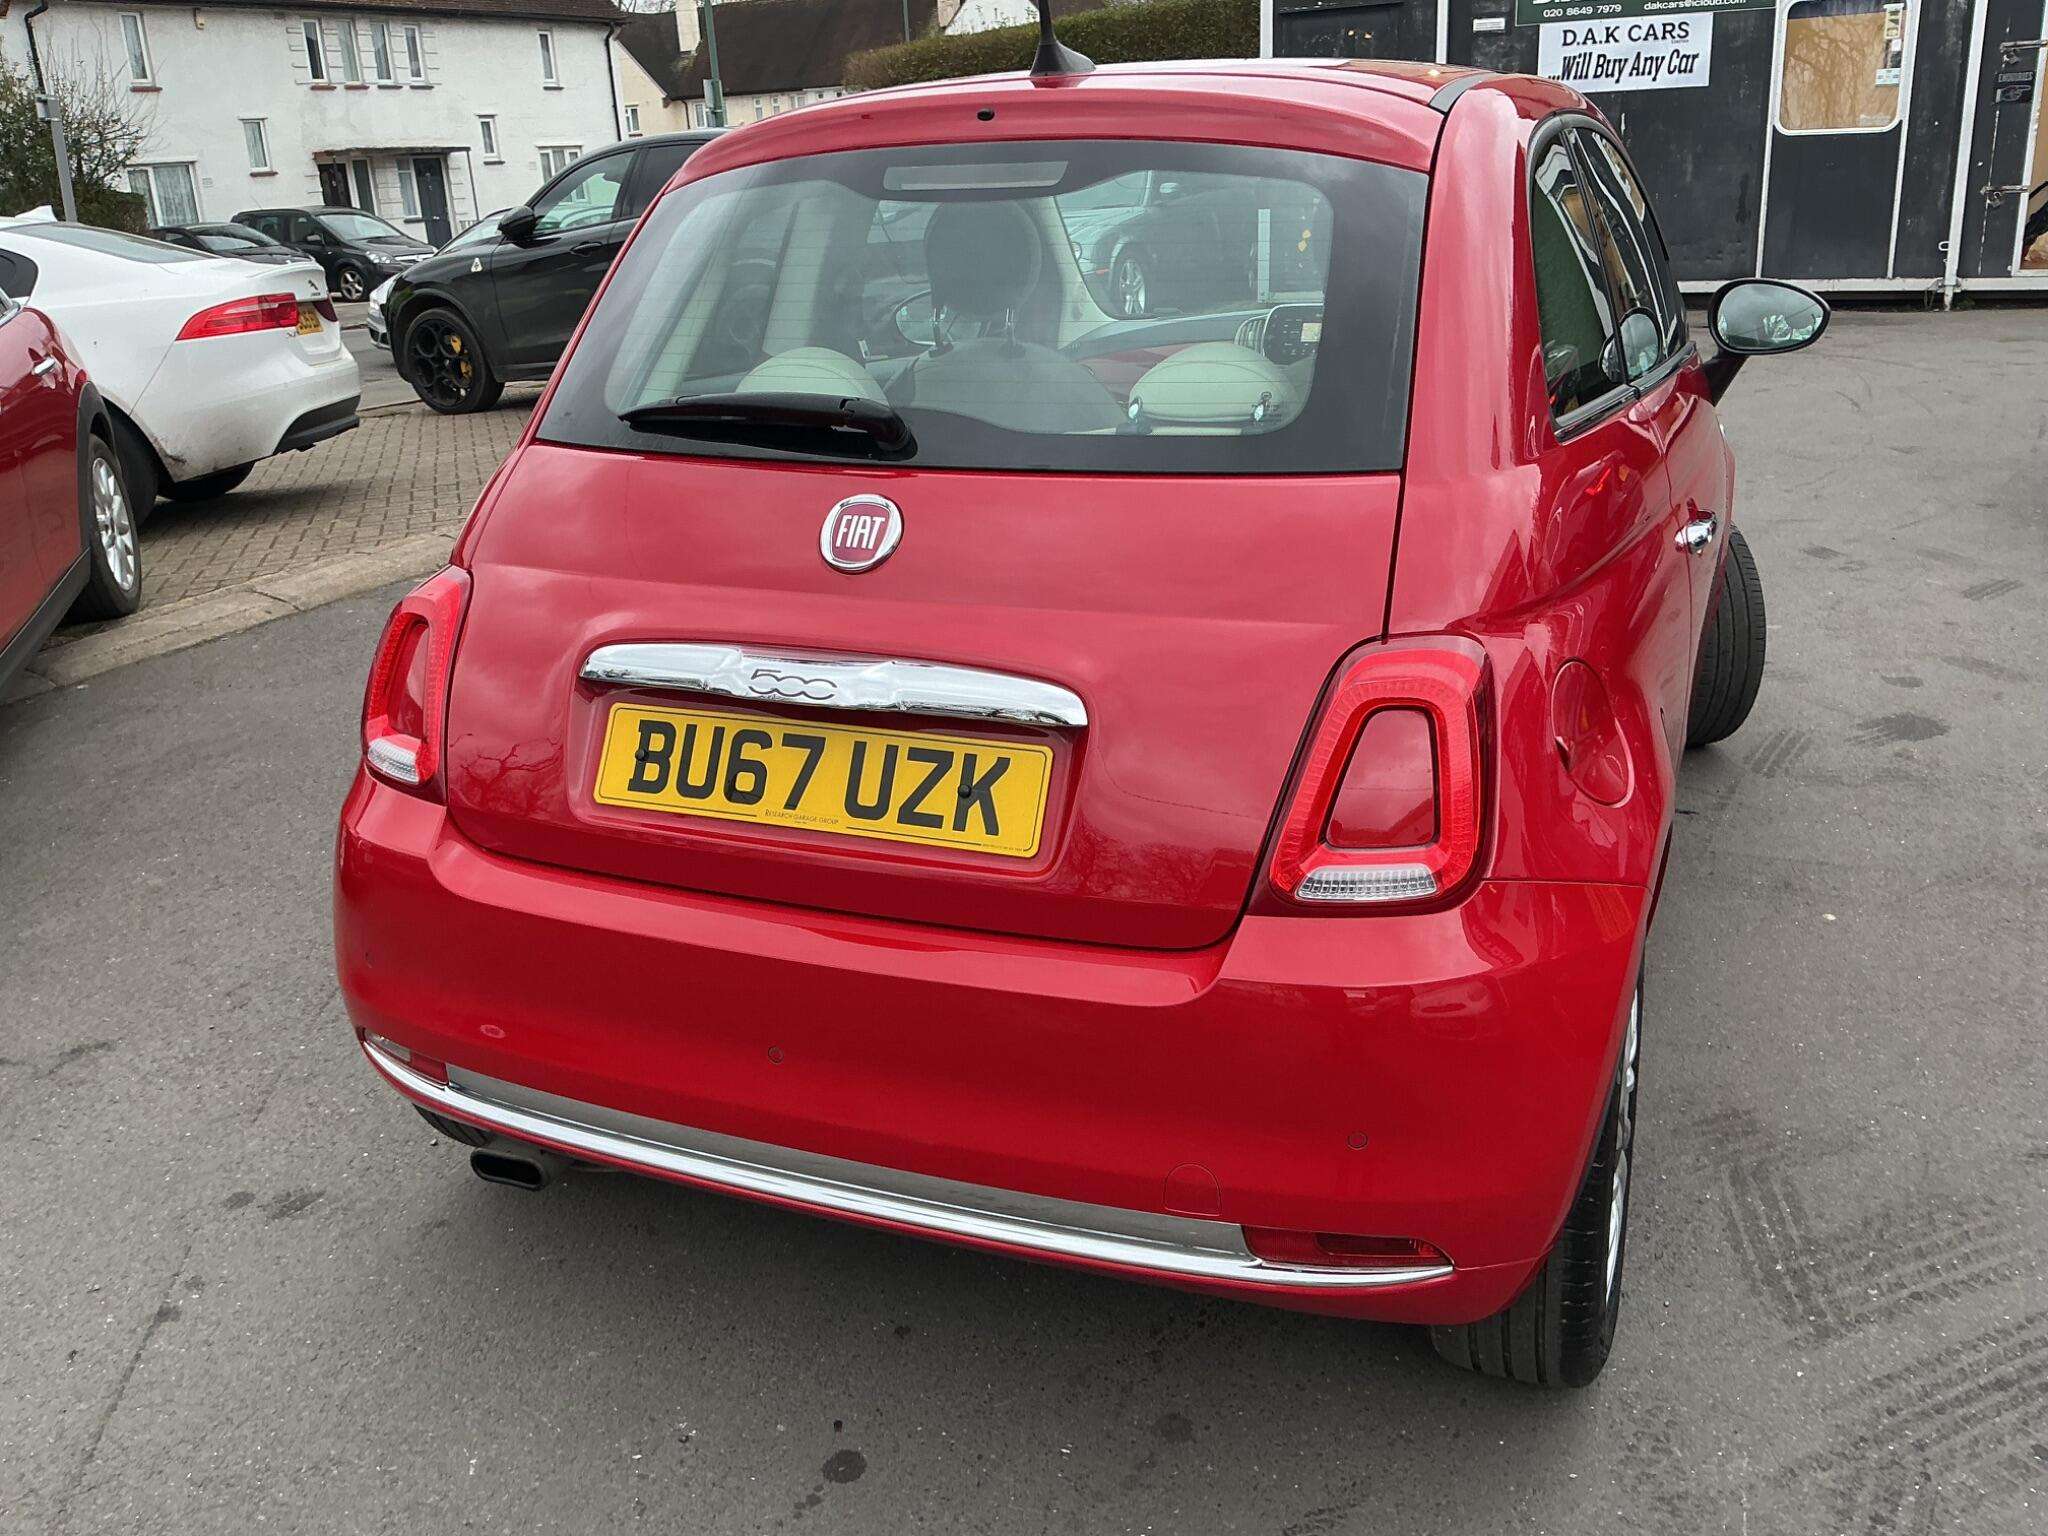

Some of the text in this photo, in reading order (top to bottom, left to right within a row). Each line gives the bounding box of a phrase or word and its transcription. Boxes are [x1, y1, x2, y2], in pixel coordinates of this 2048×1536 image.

[1543, 4, 1622, 17] 020 8649 7979
[1562, 21, 1690, 46] D.A.K CARS
[1593, 53, 1628, 84] Buy
[1628, 51, 1666, 82] Any
[1667, 48, 1699, 75] Car
[835, 514, 886, 549] FIAT
[748, 668, 838, 700] 500
[627, 719, 1011, 836] BU67 UZK
